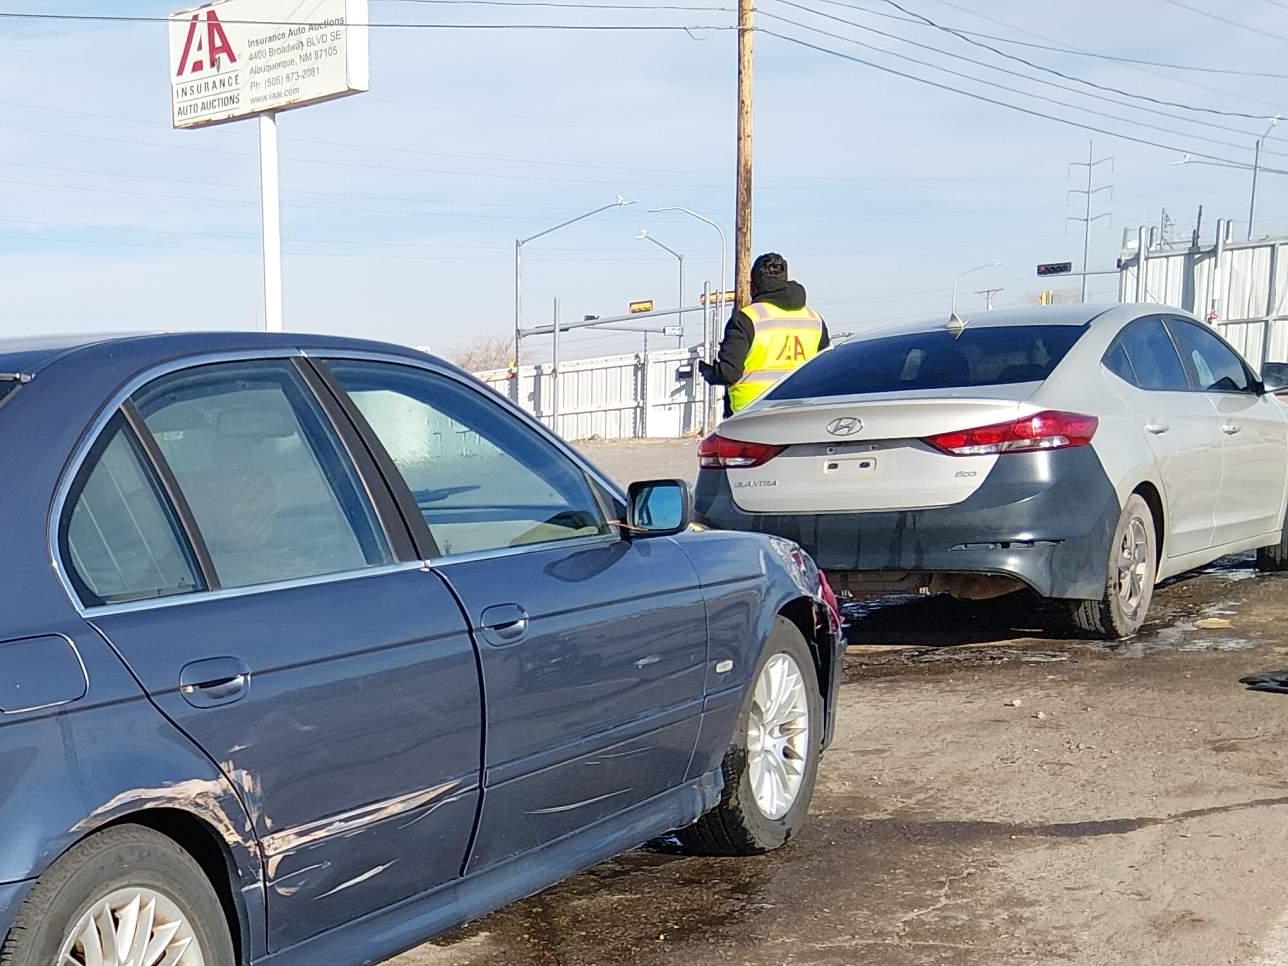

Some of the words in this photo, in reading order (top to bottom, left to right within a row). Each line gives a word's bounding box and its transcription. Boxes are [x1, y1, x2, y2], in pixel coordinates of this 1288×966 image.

[248, 32, 286, 48] Insurance
[287, 25, 306, 39] Auto
[308, 17, 345, 32] Auctions
[248, 49, 267, 61] 4400
[306, 34, 328, 48] BLVD
[329, 30, 342, 42] SE
[299, 53, 313, 64] NM
[314, 46, 338, 60] 87105
[176, 74, 240, 98] INSURANCE
[177, 102, 199, 117] AUTO
[200, 93, 240, 113] AUCTIONS
